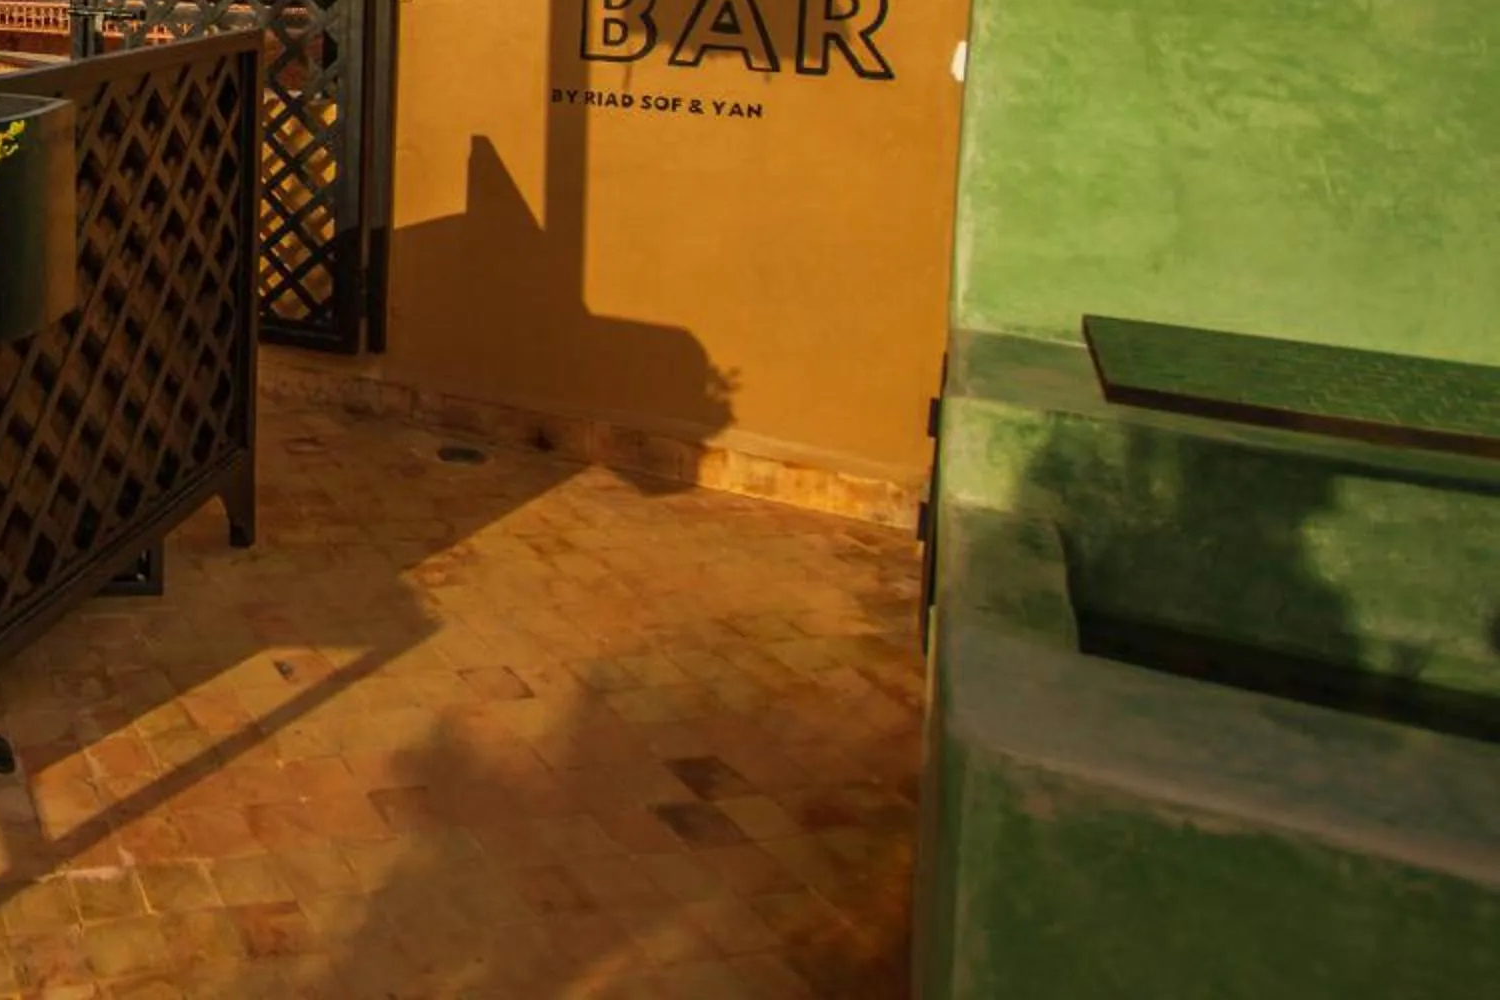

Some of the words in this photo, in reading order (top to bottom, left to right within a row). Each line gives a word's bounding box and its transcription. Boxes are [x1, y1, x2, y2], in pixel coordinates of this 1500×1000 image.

[551, 88, 579, 105] BY
[584, 91, 635, 108] RIAD
[640, 94, 683, 113] SOF
[688, 98, 705, 115] &
[711, 100, 764, 119] YAN
